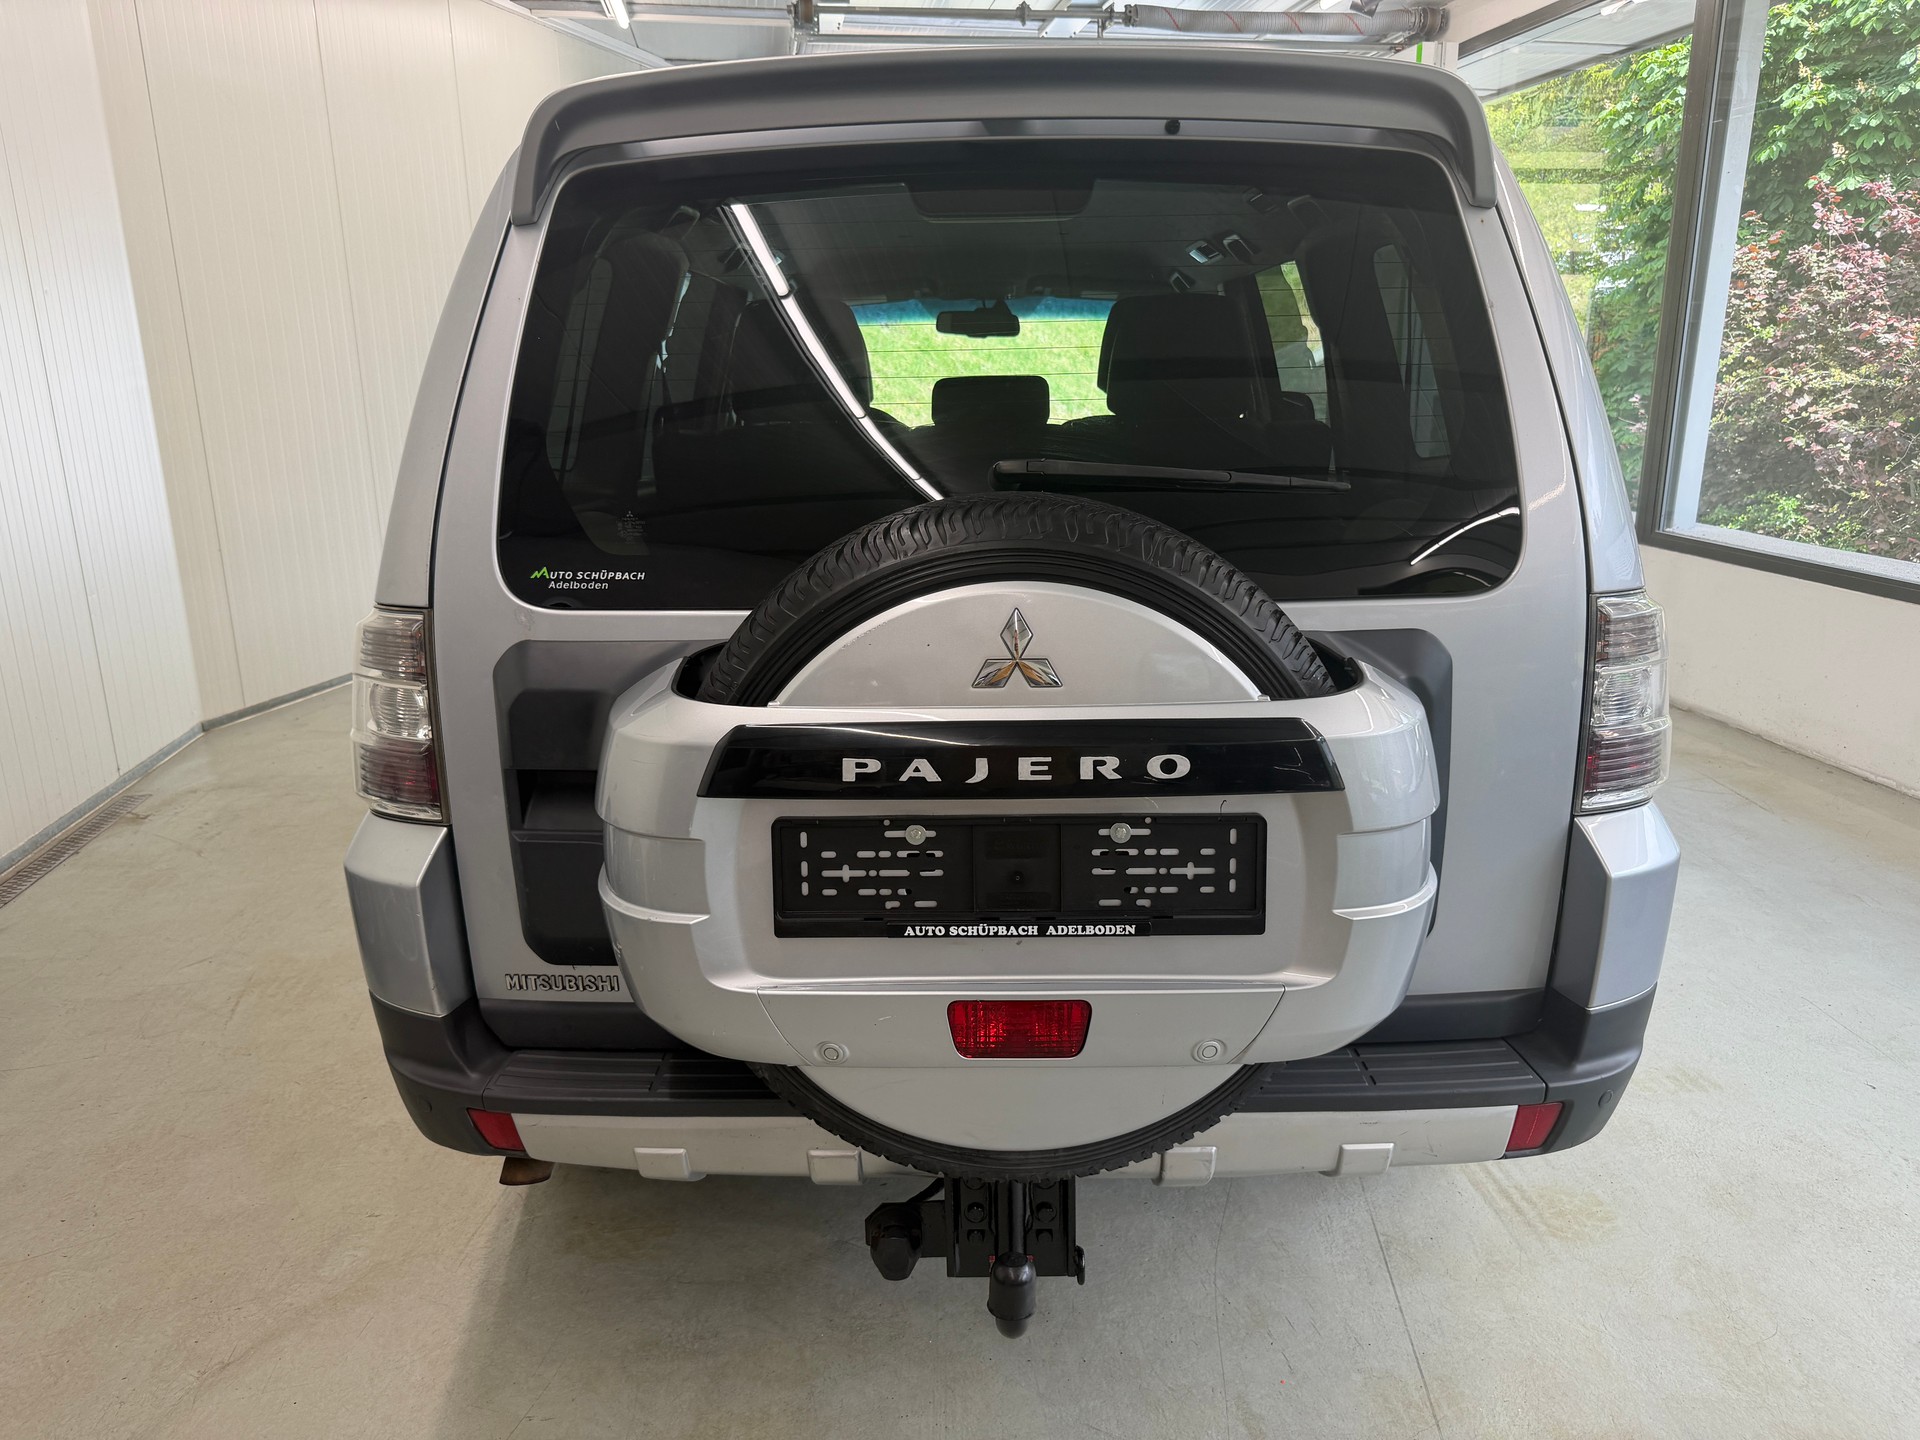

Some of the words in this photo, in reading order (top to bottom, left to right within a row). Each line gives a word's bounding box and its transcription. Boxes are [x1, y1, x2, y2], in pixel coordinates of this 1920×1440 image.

[576, 570, 646, 581] SCHÜPBACH
[548, 581, 609, 590] Adelboden
[842, 754, 1191, 784] PAJERO
[904, 925, 946, 936] AUTO
[949, 923, 1039, 936] SCHÜPBACH
[1046, 924, 1137, 936] ADELBODEN
[505, 973, 620, 992] MITSUBISHI
